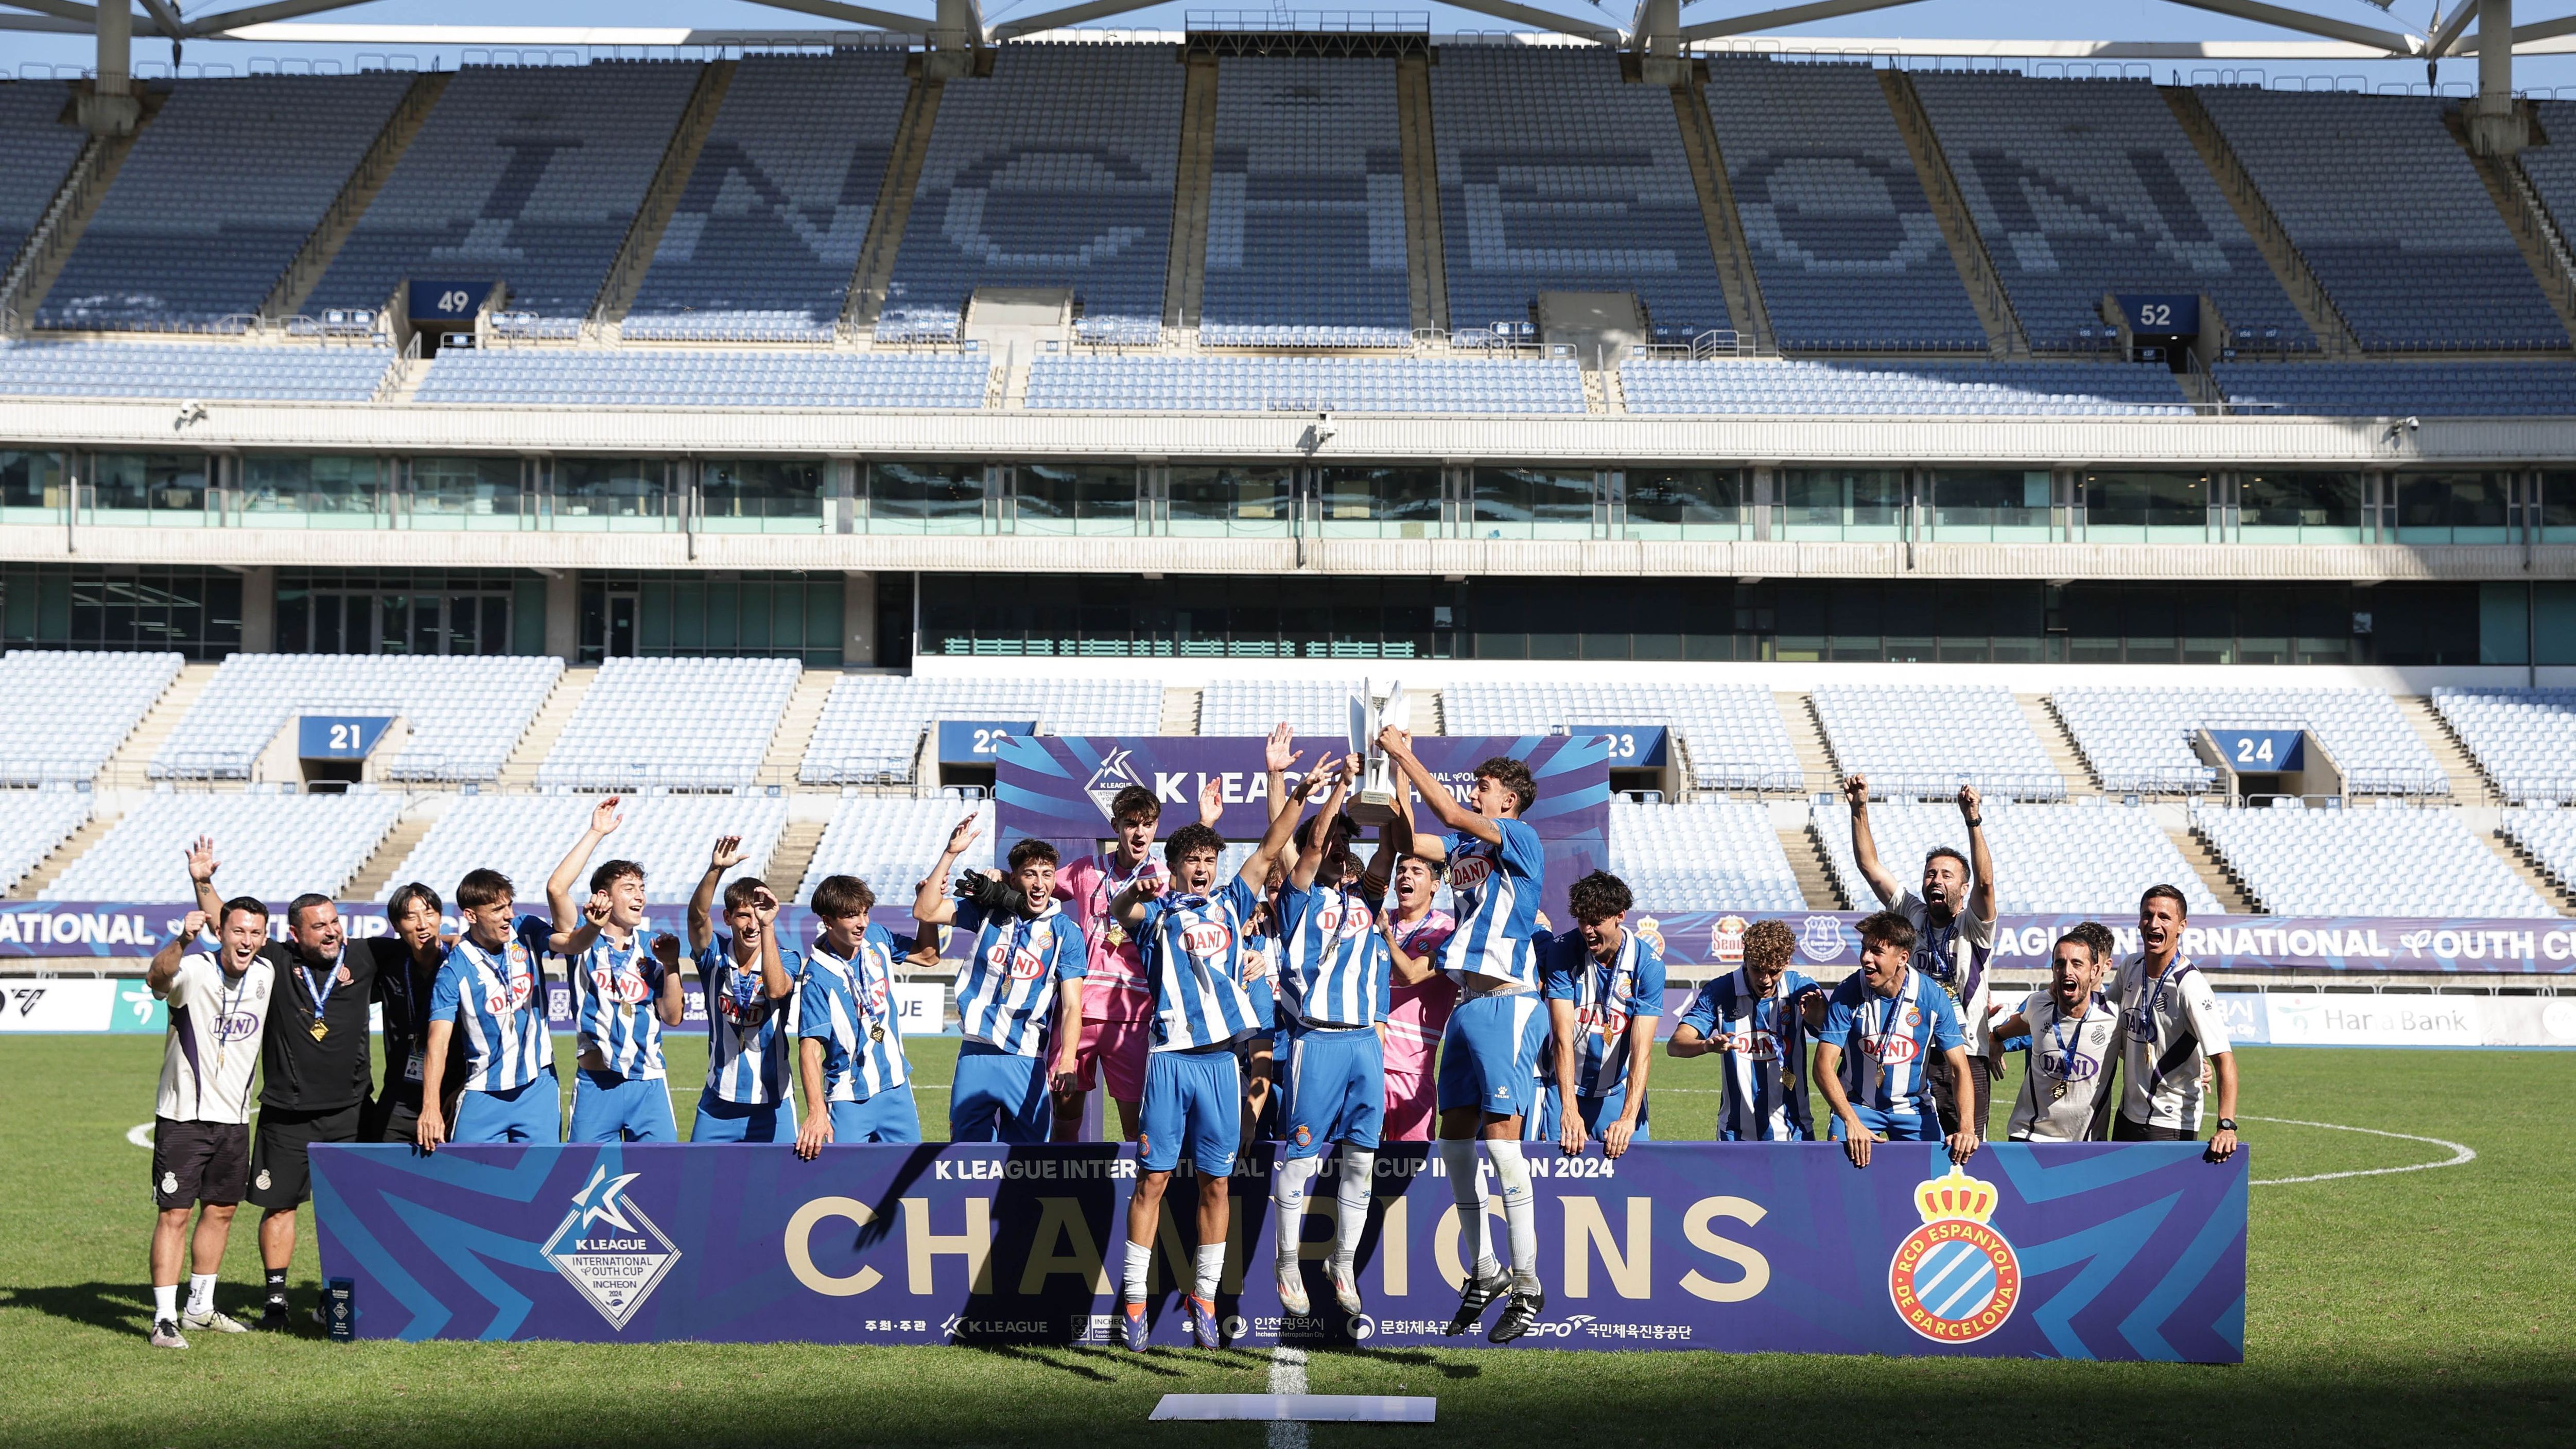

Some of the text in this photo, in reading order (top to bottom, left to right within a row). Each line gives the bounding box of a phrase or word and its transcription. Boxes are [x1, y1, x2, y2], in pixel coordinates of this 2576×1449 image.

[431, 137, 2234, 272] INCHEON
[438, 291, 469, 312] 49
[2141, 304, 2171, 325] 52
[329, 724, 361, 749] 21
[2237, 738, 2274, 762] 24
[1154, 772, 1188, 804] K
[1454, 861, 1486, 886] DANI
[347, 915, 388, 939] UP
[1185, 931, 1222, 951] DANI
[2114, 927, 2389, 957] NRNATIONAL
[597, 972, 639, 998] DANI
[1492, 988, 1513, 998] UOMO
[213, 1017, 252, 1035] DANI
[2401, 1009, 2468, 1032] Bank
[1737, 1037, 1774, 1055] DAN
[2043, 1055, 2089, 1076] DANI
[935, 1160, 952, 1180] K
[958, 1160, 1057, 1179] LEAGUE
[1063, 1159, 1264, 1179] INTERTIAL
[1373, 1158, 1425, 1178] CUP
[1555, 1158, 1615, 1178] 2024
[575, 1239, 647, 1250] K LEAGUE
[1897, 1224, 2013, 1275] RCD ESPANYOL
[572, 1257, 653, 1266] INTERNATIONAL
[622, 1267, 643, 1276] CUP
[1895, 1284, 2014, 1337] DE BARCELONA
[865, 1320, 926, 1332] 주최·주관
[968, 1321, 1049, 1333] K LEAGUE
[1182, 1321, 1194, 1333] 후
[1254, 1317, 1324, 1331] 인천광역시
[1381, 1320, 1483, 1336] 문화체육관부
[1524, 1322, 1572, 1338] SPO
[1586, 1323, 1692, 1340] 국민체육진흥공단
